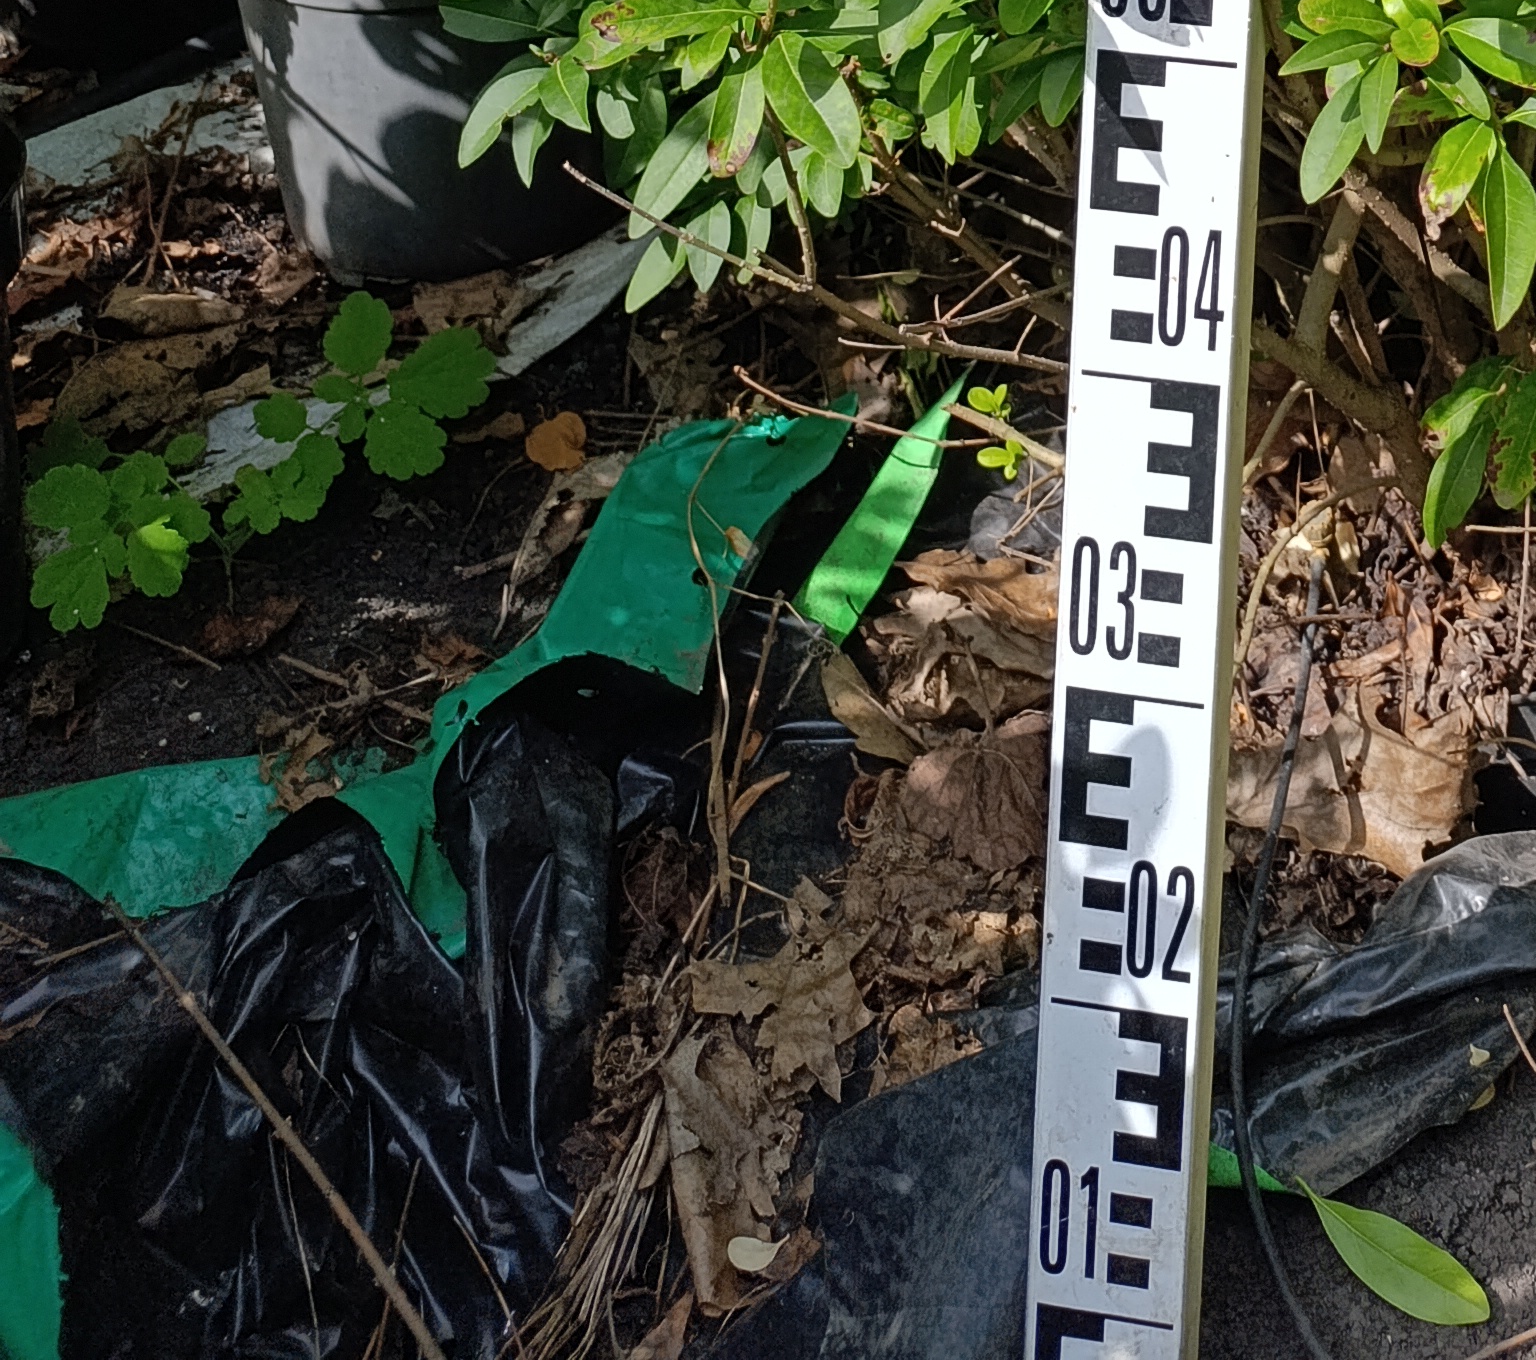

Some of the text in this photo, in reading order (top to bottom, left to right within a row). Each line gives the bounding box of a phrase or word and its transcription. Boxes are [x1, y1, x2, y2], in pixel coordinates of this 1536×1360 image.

[1157, 225, 1225, 352] 04
[1069, 535, 1137, 661] 03
[1126, 859, 1196, 984] 02
[1039, 1157, 1100, 1280] 01
